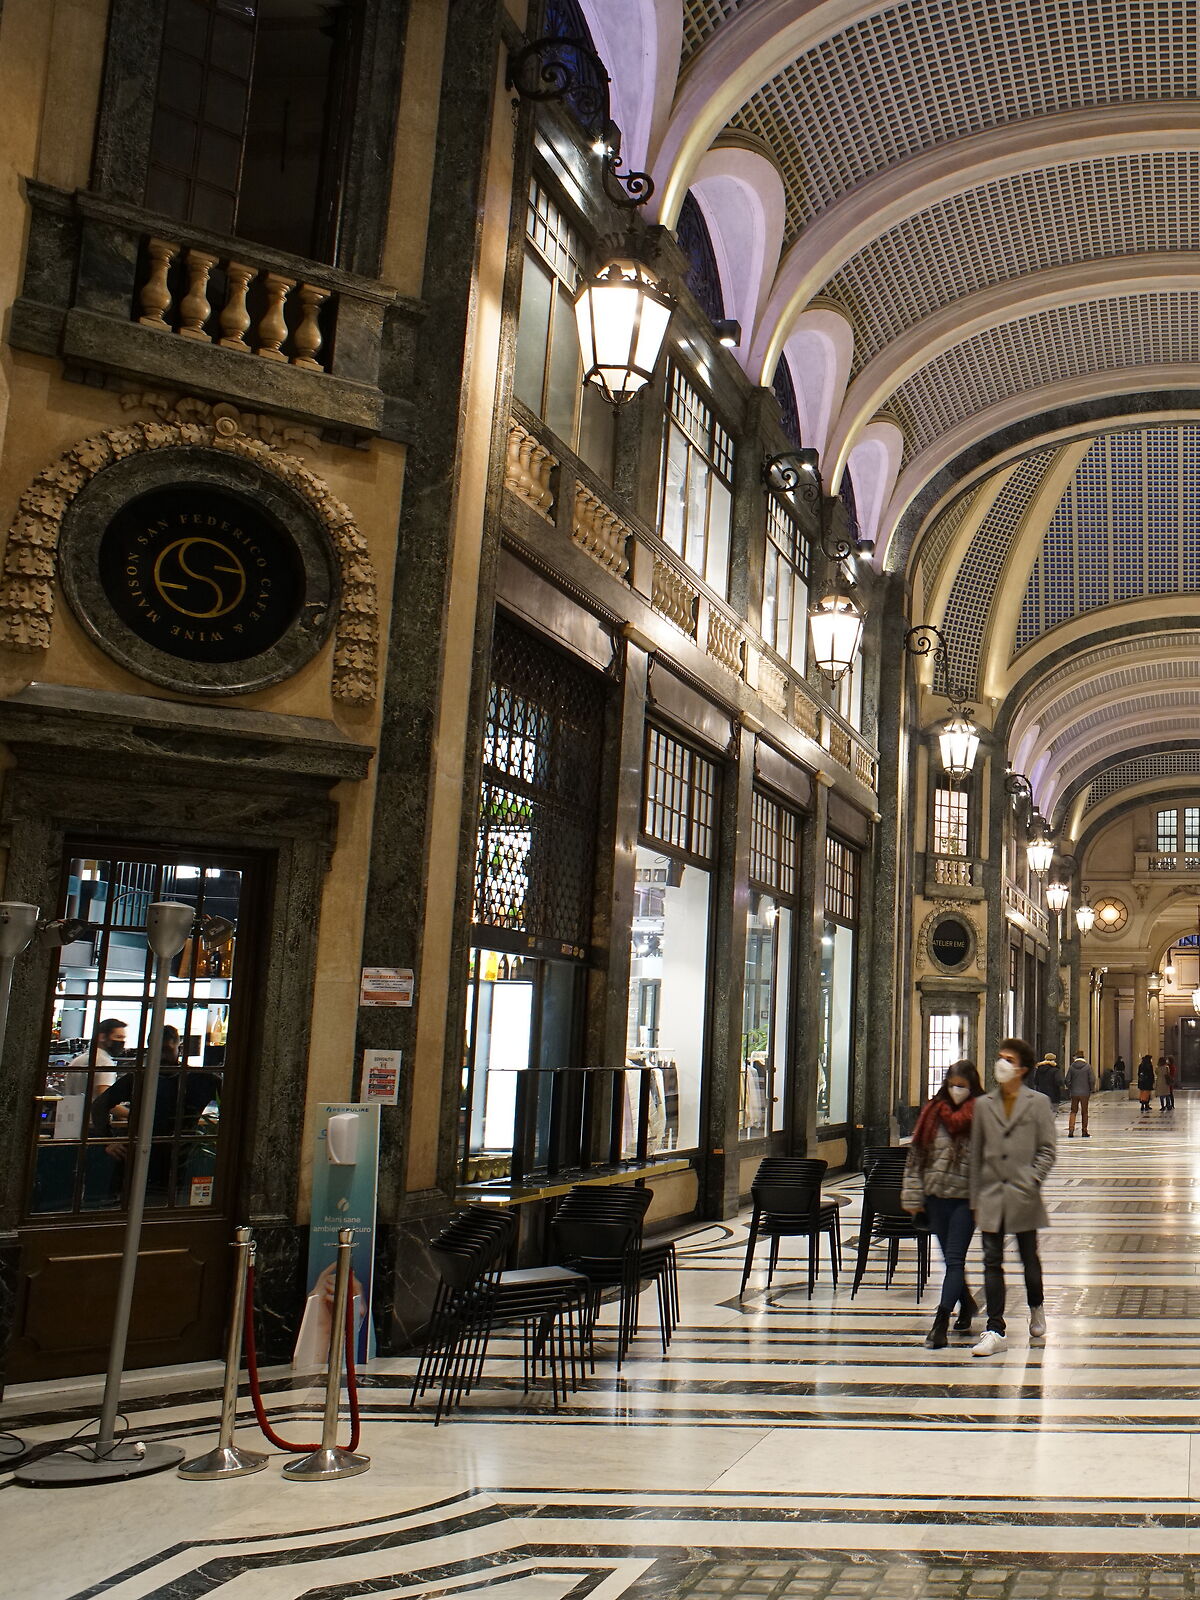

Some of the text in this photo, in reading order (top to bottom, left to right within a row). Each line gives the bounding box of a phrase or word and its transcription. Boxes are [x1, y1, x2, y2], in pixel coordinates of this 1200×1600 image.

[137, 519, 169, 545] SAN
[177, 513, 267, 567] FEDERICO
[126, 552, 161, 624] MAISON
[169, 624, 224, 641] WINE
